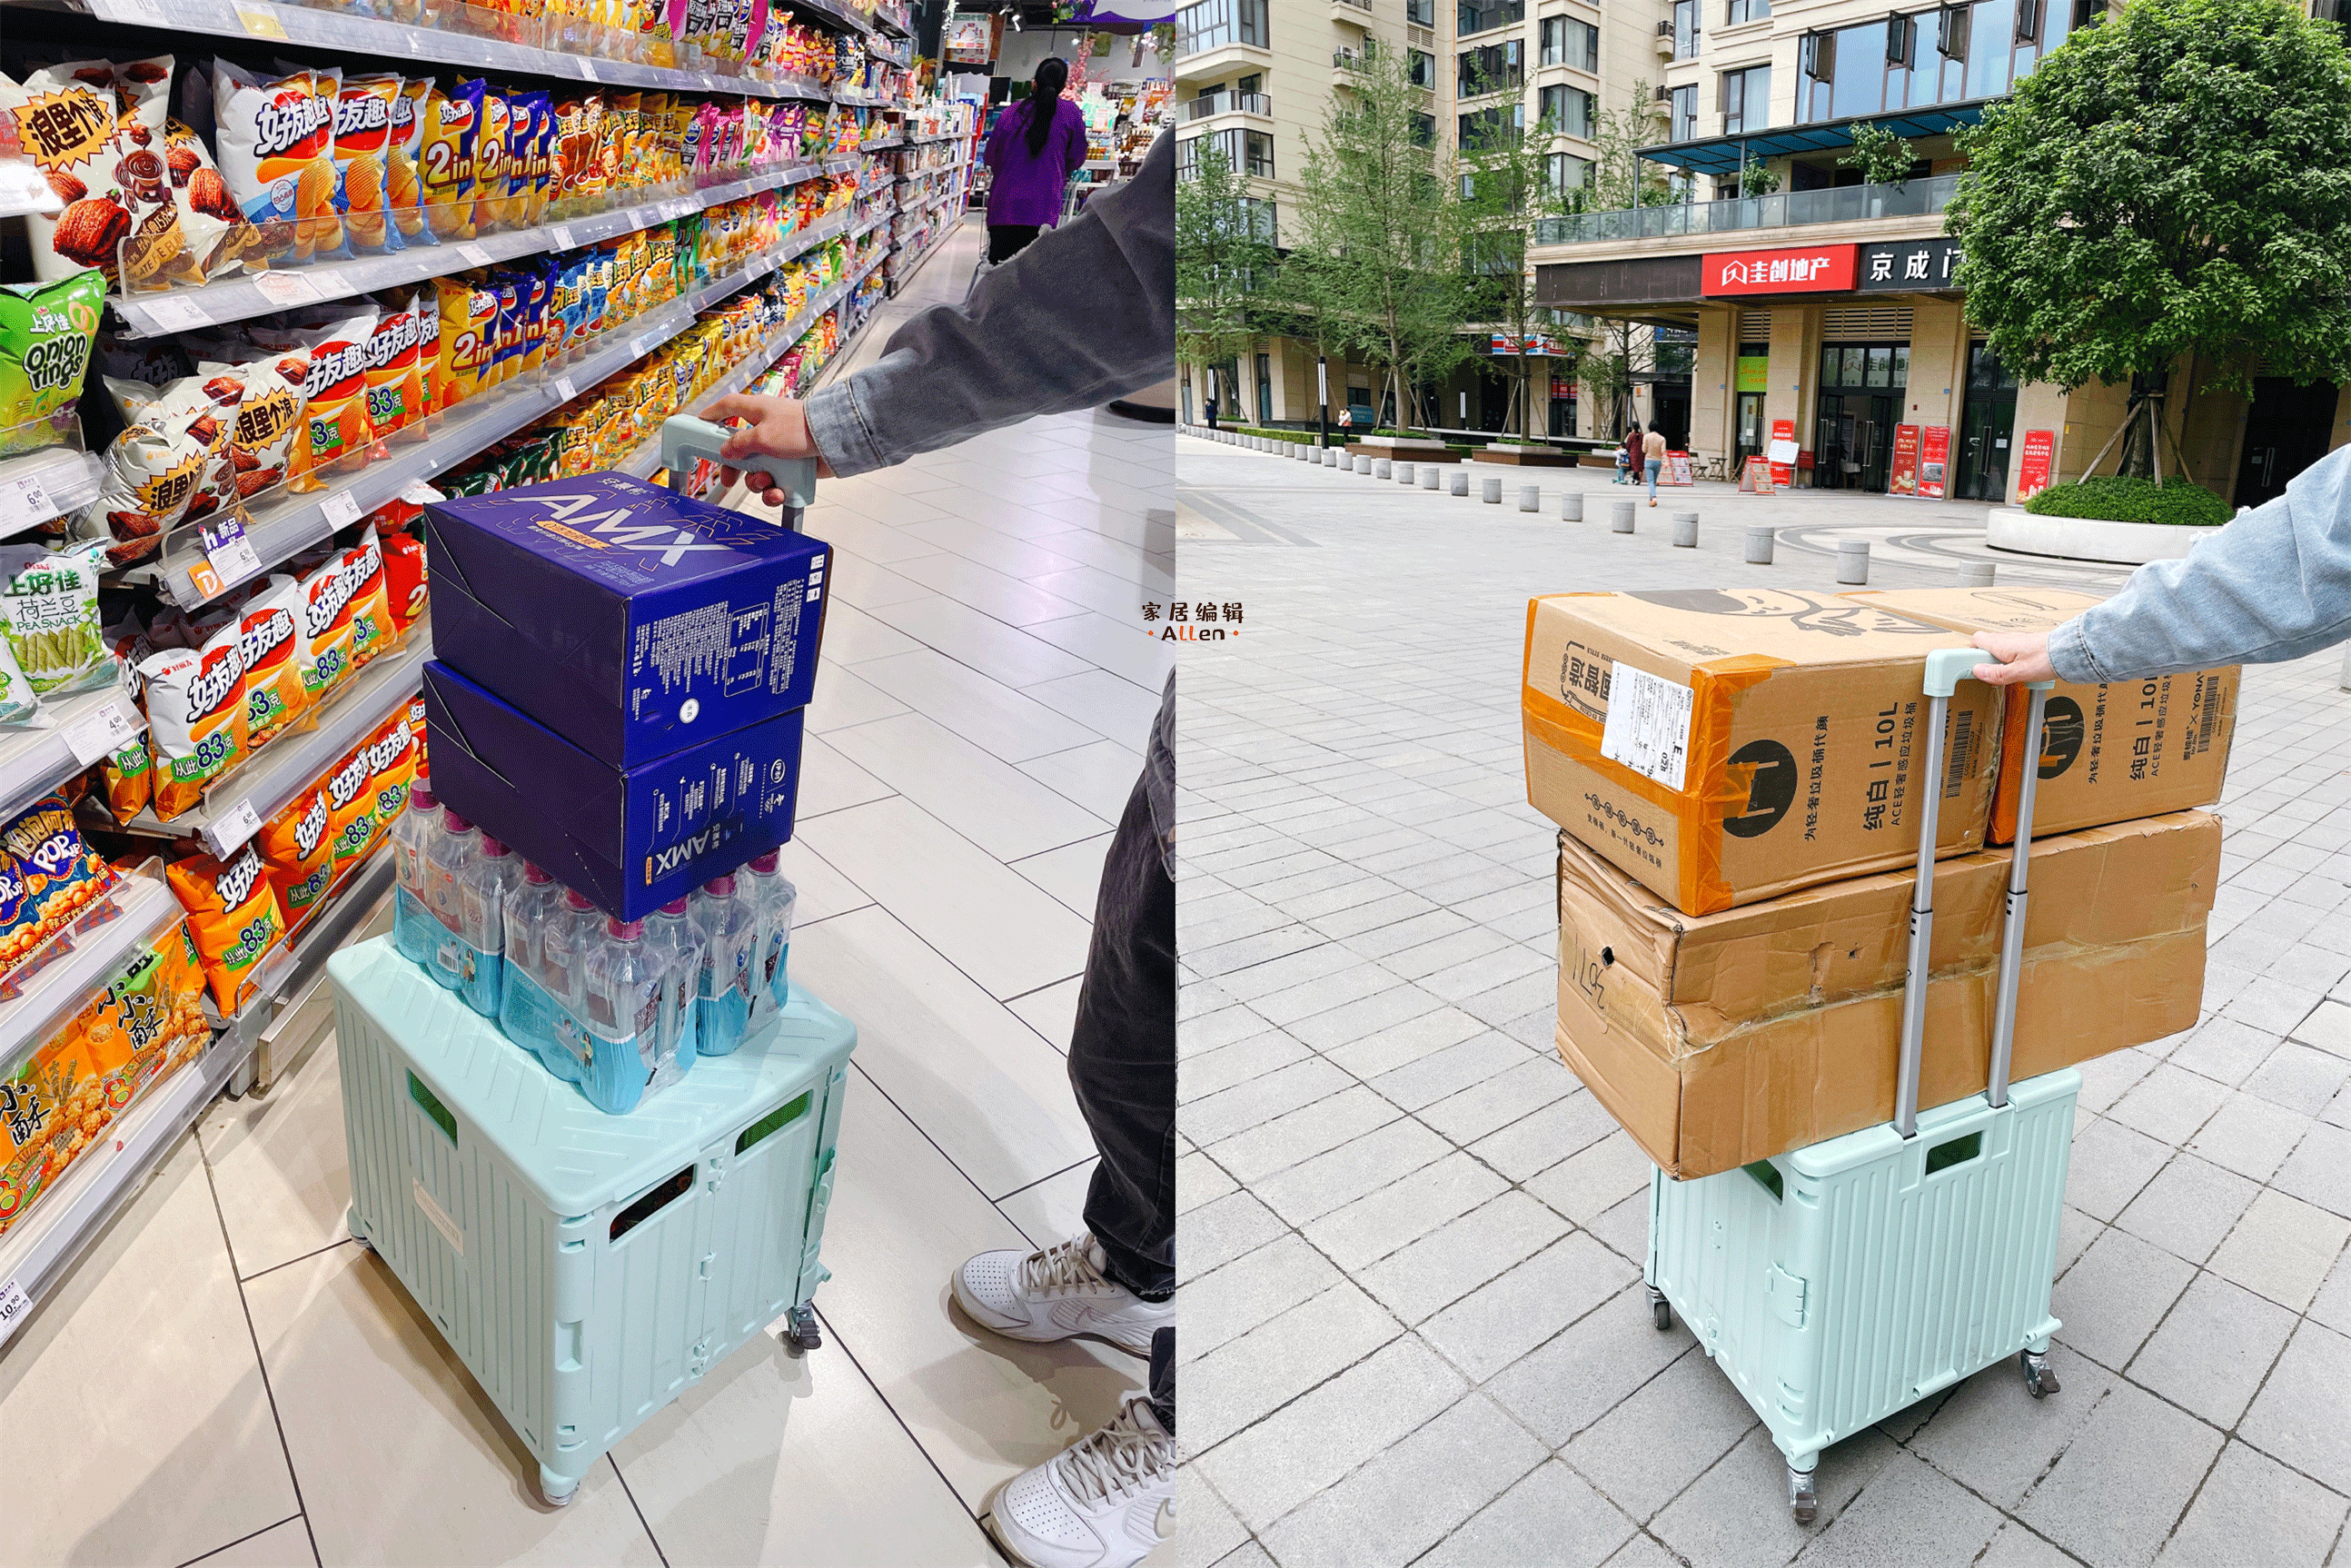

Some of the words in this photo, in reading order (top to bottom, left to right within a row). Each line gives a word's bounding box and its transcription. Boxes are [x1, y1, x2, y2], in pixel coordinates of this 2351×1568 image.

[1750, 256, 1830, 283] 圭创地产
[238, 397, 293, 444] 浪里个浪
[510, 493, 735, 567] AMX
[4, 570, 82, 599] 上好佳
[2129, 737, 2151, 780] 纯白
[1862, 779, 1890, 831] 纯白
[656, 829, 709, 876] AMX
